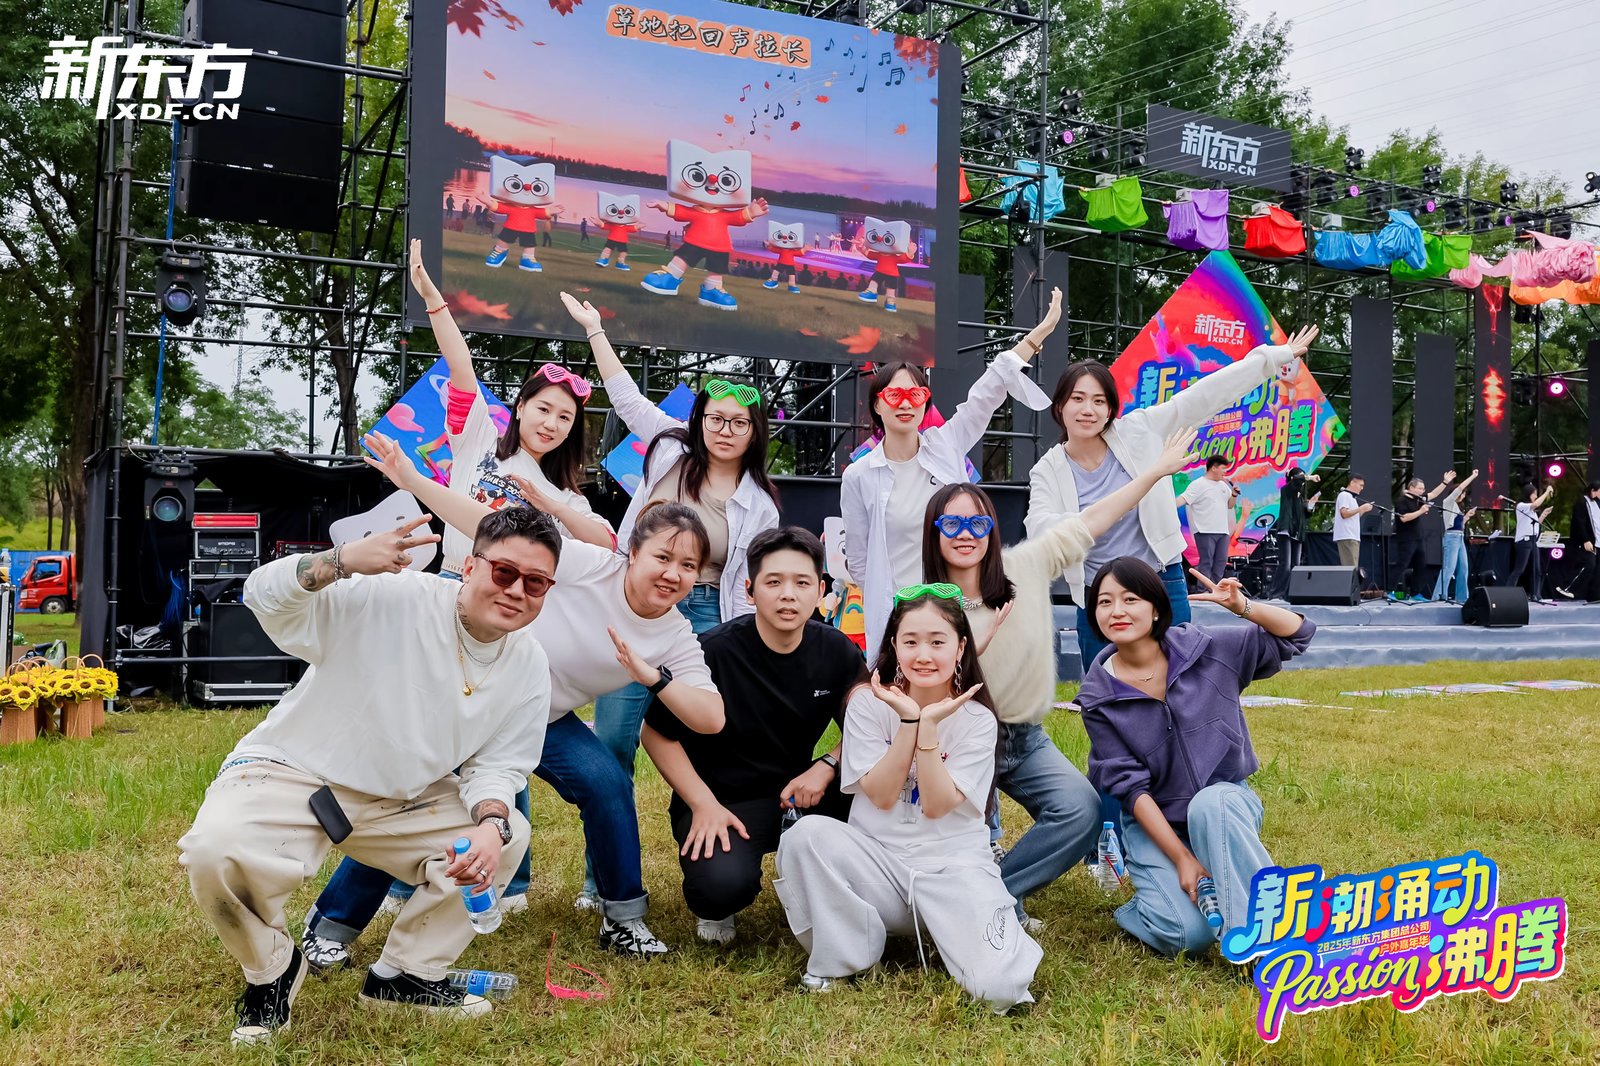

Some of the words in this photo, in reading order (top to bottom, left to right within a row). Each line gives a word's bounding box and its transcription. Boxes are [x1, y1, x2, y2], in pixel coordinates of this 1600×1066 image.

[612, 7, 808, 64] 草地把回声拉长
[1181, 122, 1261, 168] 新东方
[1208, 159, 1257, 177] XDF.CN
[1194, 313, 1246, 342] 新东方
[1212, 336, 1243, 345] XDF.CN
[1238, 404, 1312, 466] 沸腾
